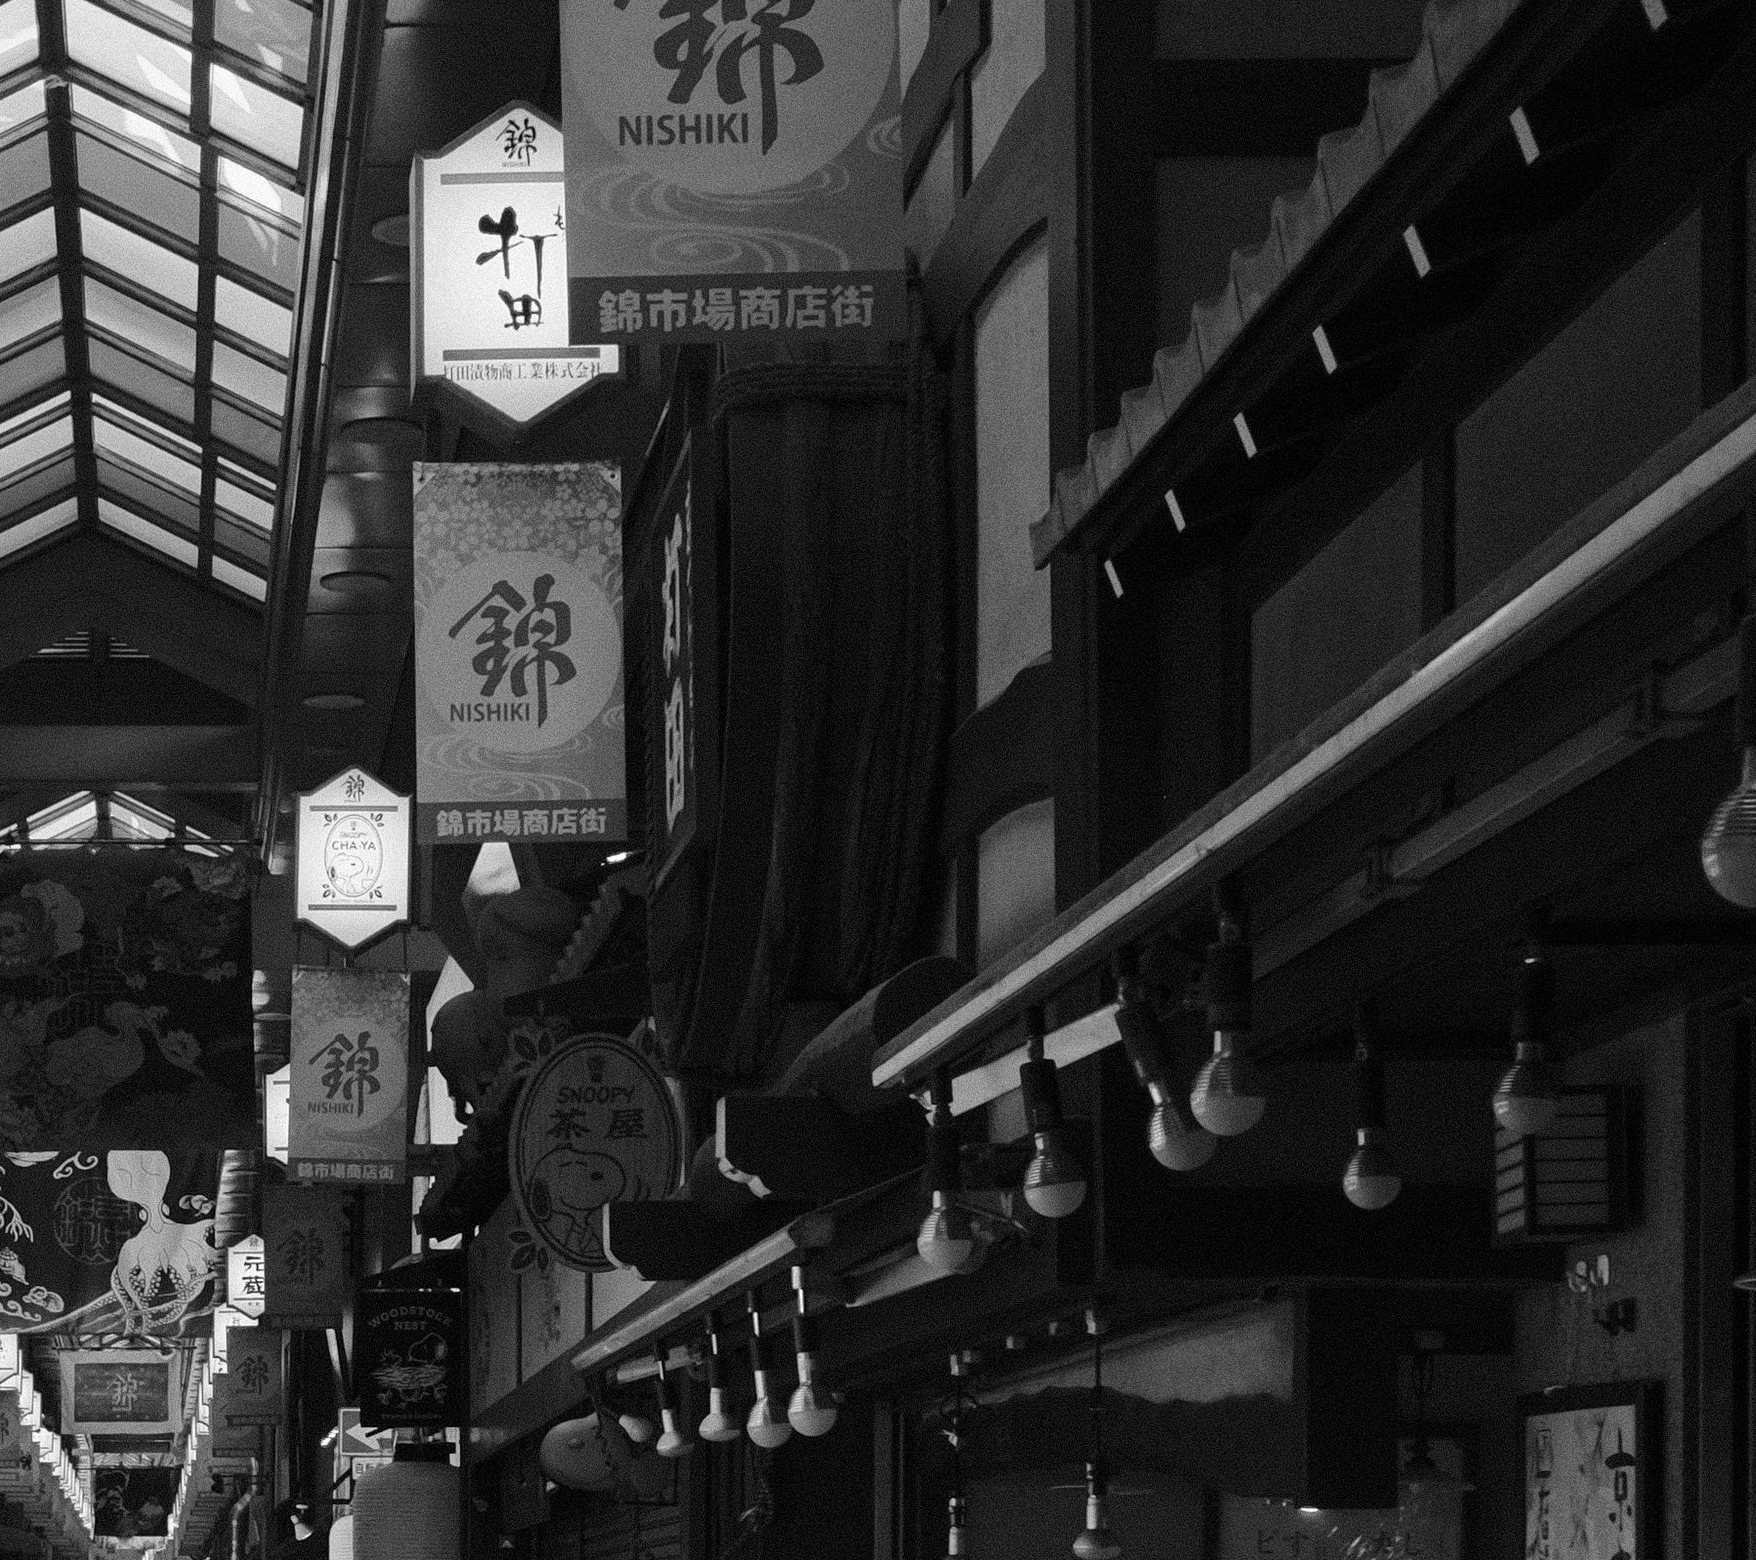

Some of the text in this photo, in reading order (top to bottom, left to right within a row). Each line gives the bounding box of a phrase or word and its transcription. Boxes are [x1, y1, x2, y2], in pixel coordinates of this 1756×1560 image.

[496, 117, 538, 167] 錦
[618, 113, 749, 147] NISHIKI
[598, 285, 873, 334] 錦市場商店街
[447, 573, 578, 730] 錦
[449, 702, 531, 724] NISHIKI
[436, 807, 607, 837] 錦市場商店街
[309, 1031, 381, 1118] 錦
[559, 1086, 636, 1104] SNOOPY
[547, 1108, 648, 1139] 茶屋
[368, 1305, 452, 1328] WOODSTOCK
